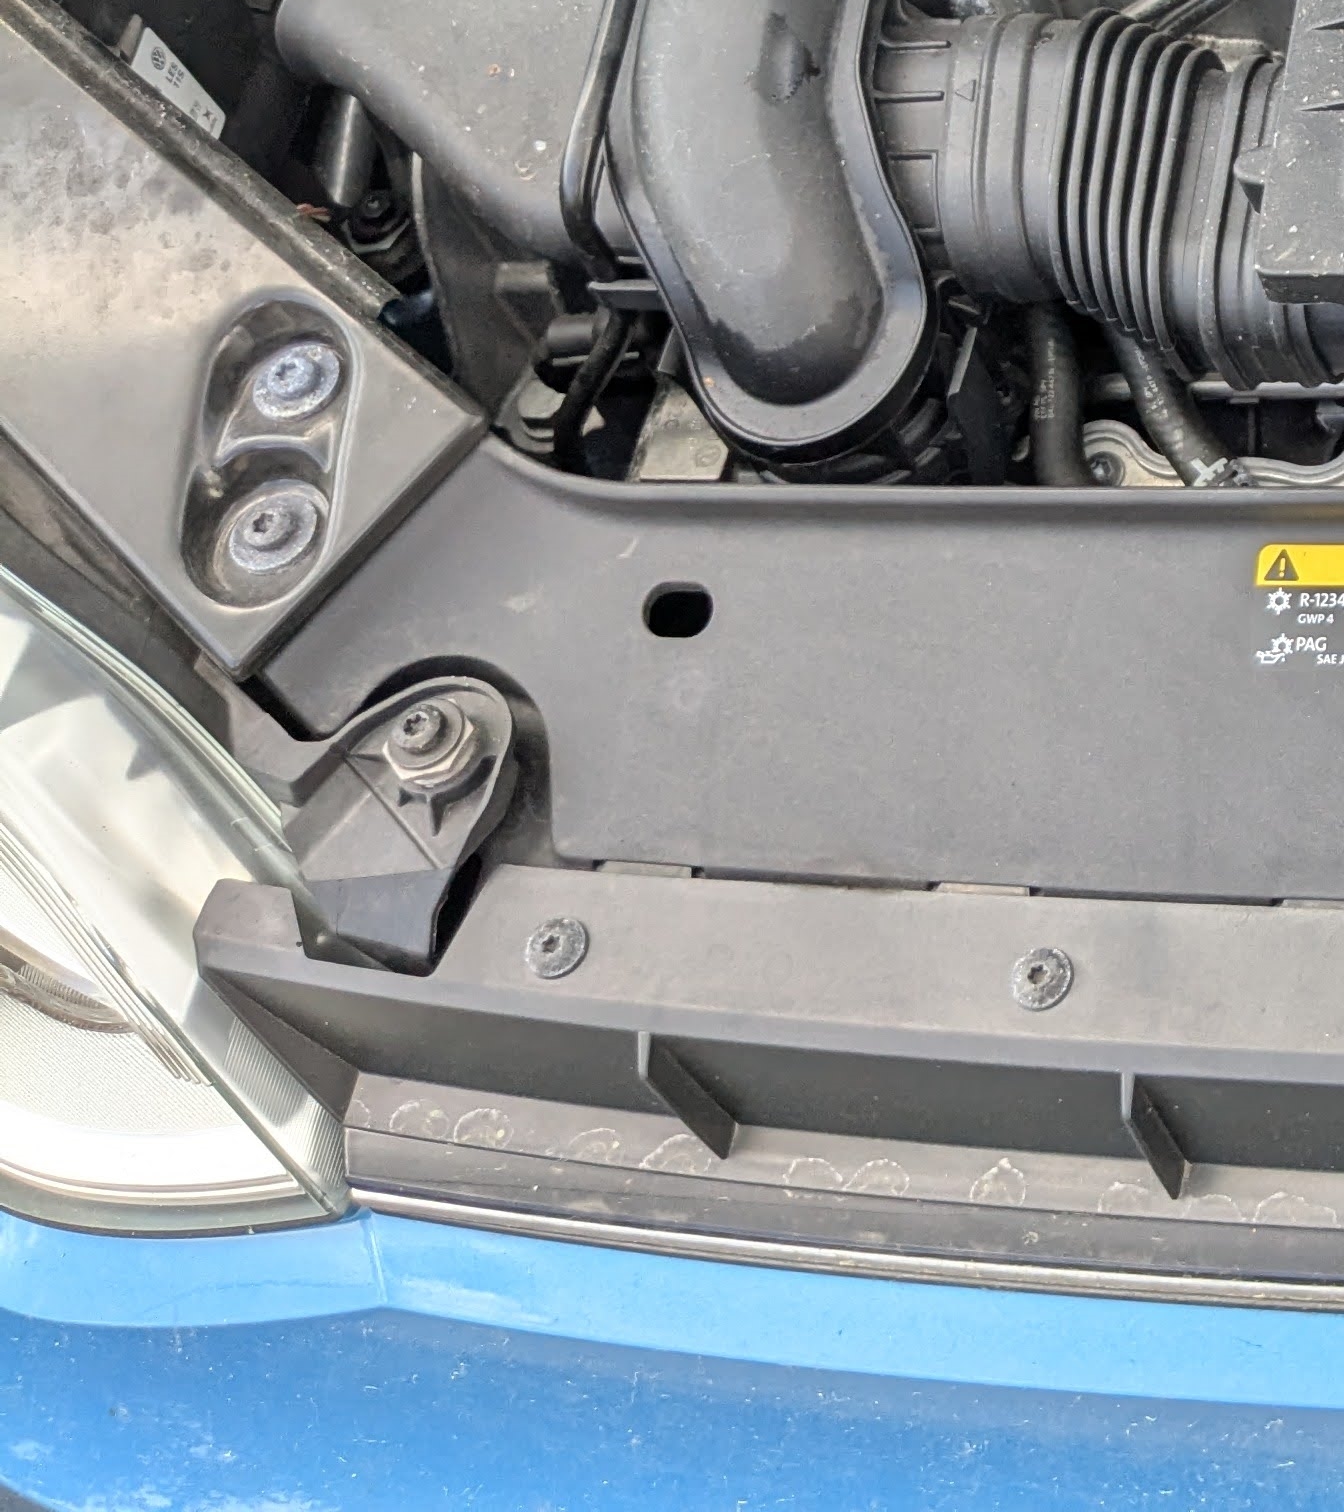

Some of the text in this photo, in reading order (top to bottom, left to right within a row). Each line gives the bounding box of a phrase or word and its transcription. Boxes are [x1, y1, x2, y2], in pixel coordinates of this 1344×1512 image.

[1297, 614, 1324, 624] GWP
[1326, 614, 1334, 624] 4
[1296, 636, 1327, 651] PAG
[1317, 654, 1337, 664] SAE
